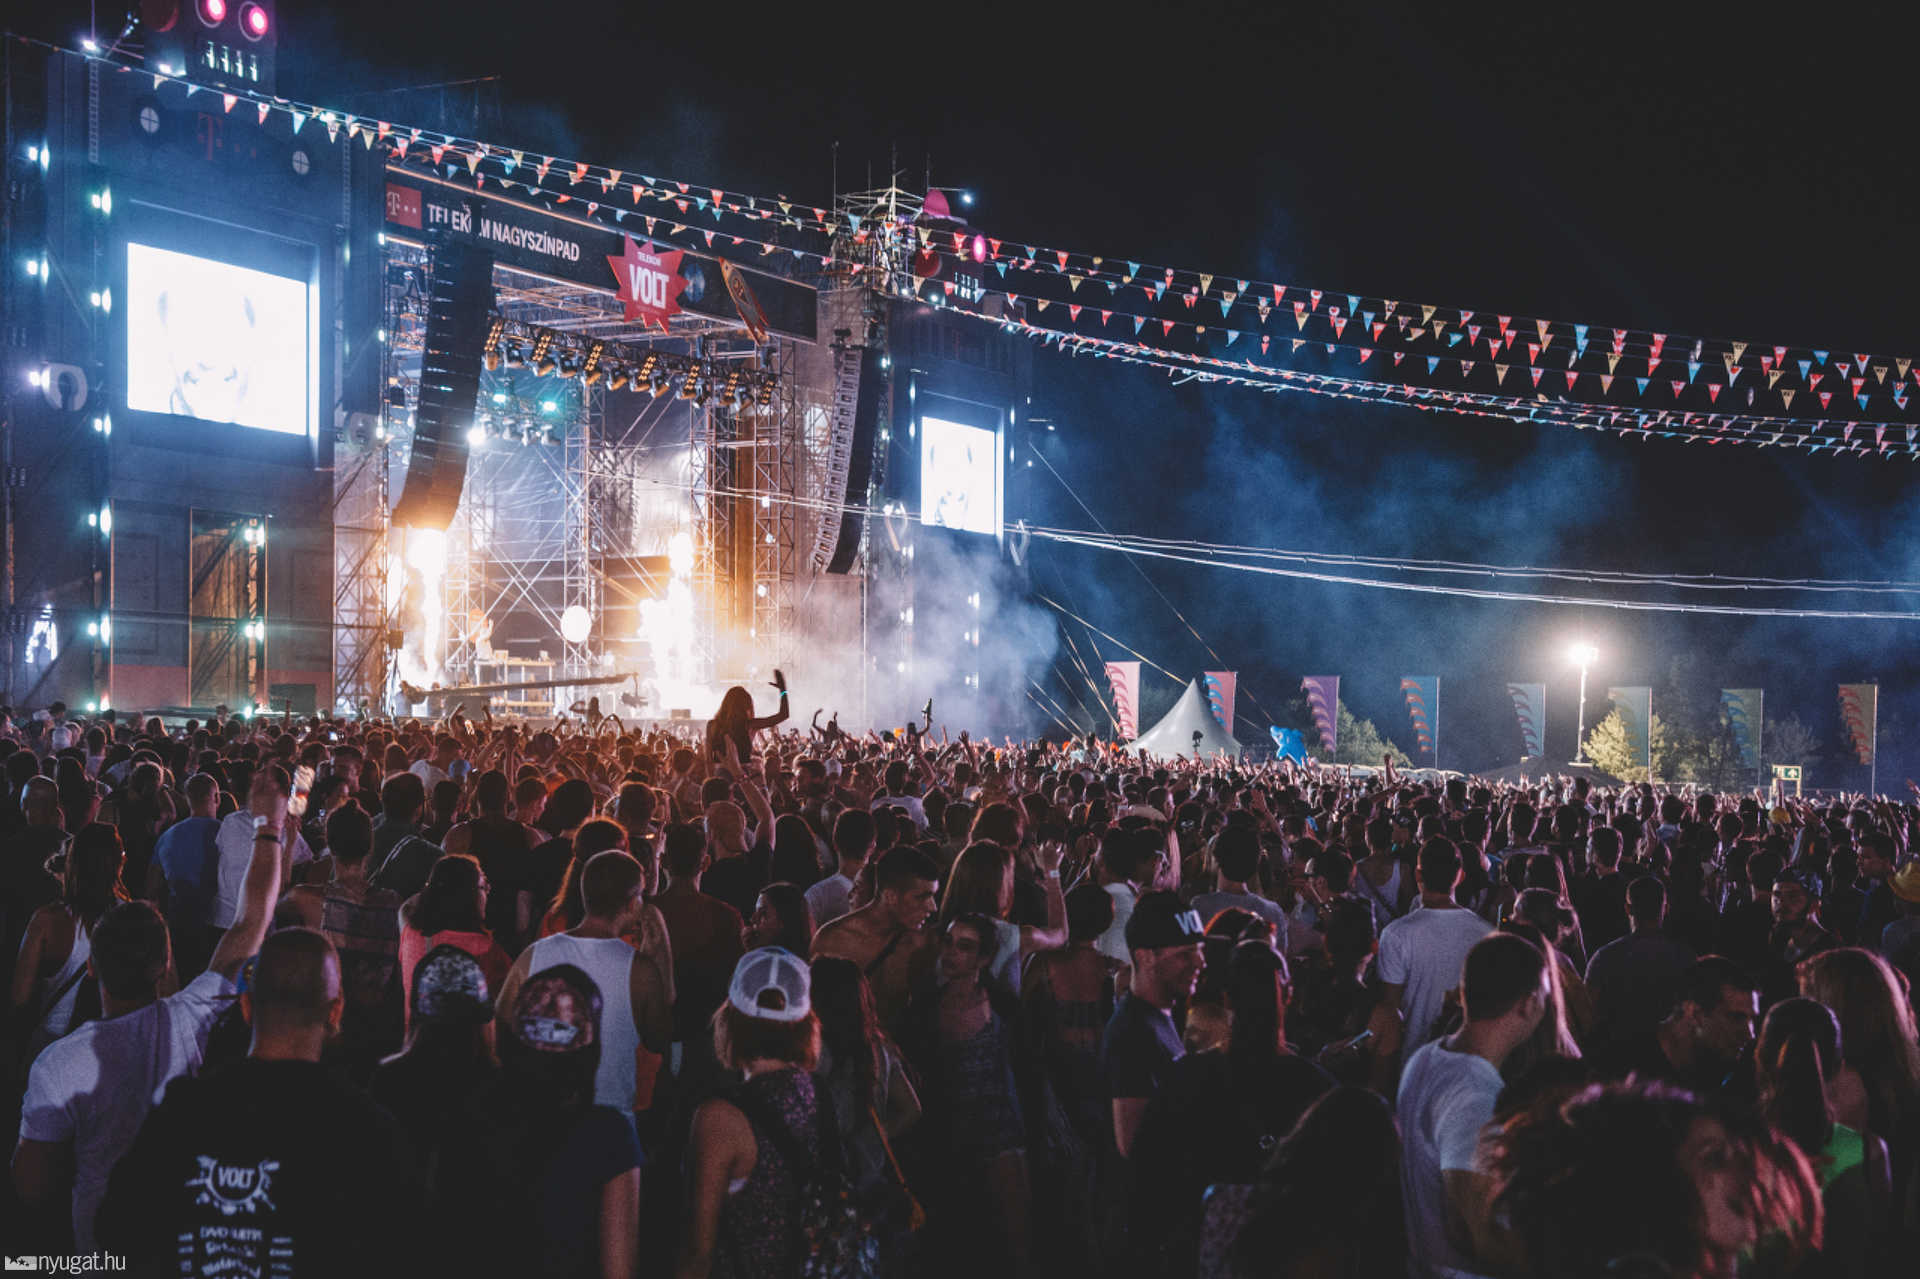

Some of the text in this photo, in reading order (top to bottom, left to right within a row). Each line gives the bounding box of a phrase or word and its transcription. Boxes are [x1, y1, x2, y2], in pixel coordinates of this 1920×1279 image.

[427, 203, 580, 261] TELEKM NAGYSZÍNPAD
[629, 263, 670, 309] VOLT
[218, 1166, 256, 1189] VOLT
